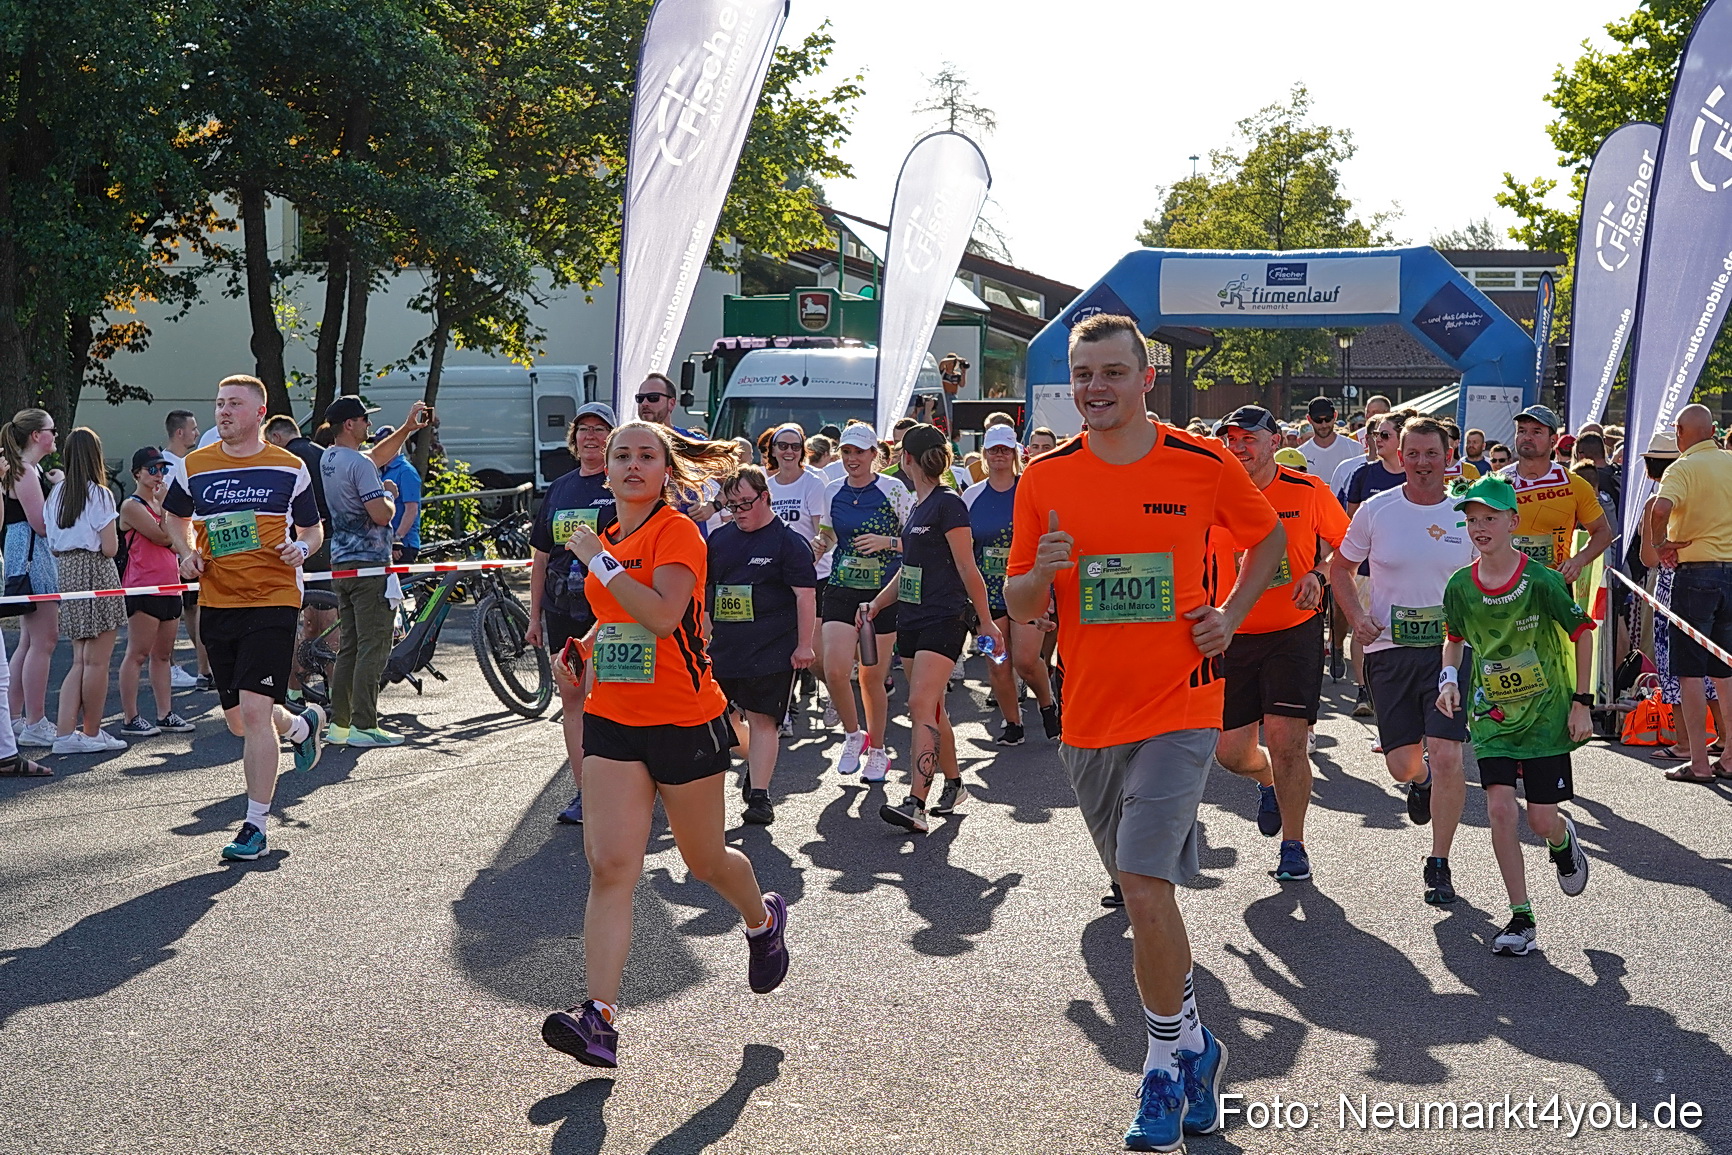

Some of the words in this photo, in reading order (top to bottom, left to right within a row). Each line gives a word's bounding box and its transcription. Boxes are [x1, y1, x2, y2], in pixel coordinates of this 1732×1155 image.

[709, 6, 758, 129] AUTOMOBILE
[1609, 149, 1655, 252] Fischer
[1274, 270, 1304, 279] Fischer
[642, 219, 706, 379] scher-automobile.de
[1251, 286, 1341, 303] firmenlauf
[738, 375, 778, 385] abavent
[214, 486, 273, 500] Fischer
[219, 497, 268, 505] AUTOMOBILE
[1516, 494, 1533, 505] AX
[1536, 488, 1573, 501] BÖGL
[777, 509, 800, 522] ÖD
[1143, 504, 1187, 516] THULE
[214, 525, 250, 544] 1818
[250, 525, 258, 544] 2022
[563, 520, 585, 533] 86
[228, 540, 247, 548] Florian
[849, 568, 870, 579] 720
[1095, 577, 1157, 601] 1401
[1161, 580, 1171, 612] 2022
[1482, 578, 1529, 606] MONSTERSTARK
[721, 597, 741, 610] 866
[1085, 586, 1093, 611] RUN
[1099, 602, 1126, 611] Seidel
[1128, 602, 1156, 610] Marco
[1400, 620, 1439, 634] 1971
[598, 643, 643, 663] 1392
[643, 647, 652, 675] 2022
[1499, 672, 1522, 689] 89
[1533, 666, 1545, 688] 2022
[1491, 689, 1512, 697] Pfindel
[1513, 683, 1539, 694] Matthias
